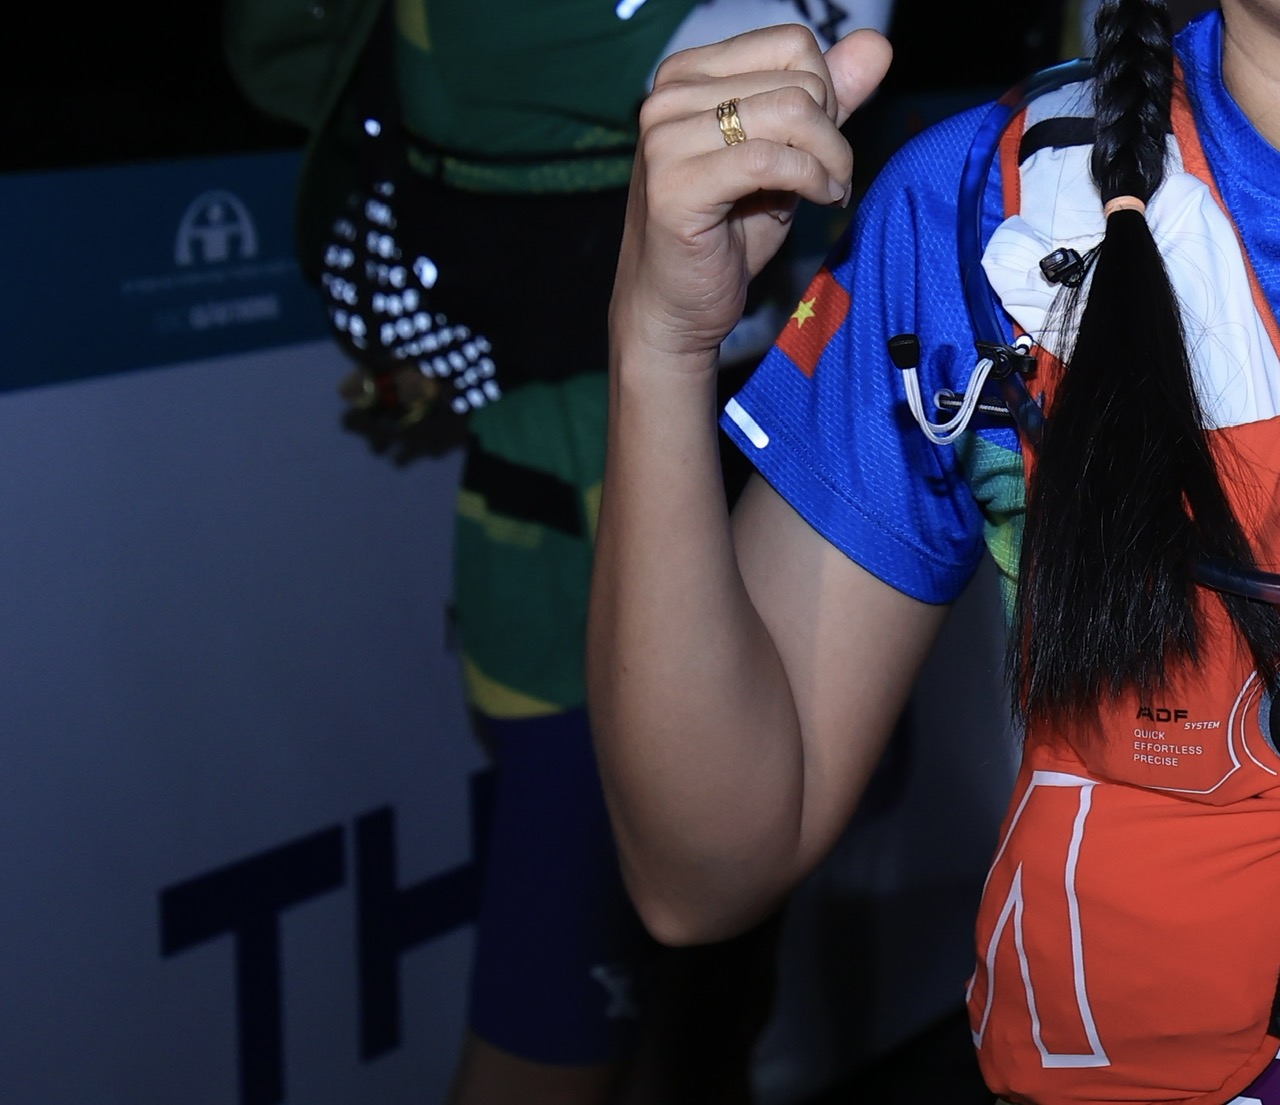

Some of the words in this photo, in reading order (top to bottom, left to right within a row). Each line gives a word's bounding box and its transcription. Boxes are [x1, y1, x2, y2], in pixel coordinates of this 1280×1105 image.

[1136, 706, 1188, 723] ADF
[1184, 721, 1220, 730] SYSTEM
[1133, 728, 1165, 740] QUICK
[1133, 741, 1203, 755] EFFORTLESS
[1133, 753, 1179, 767] PRECISE
